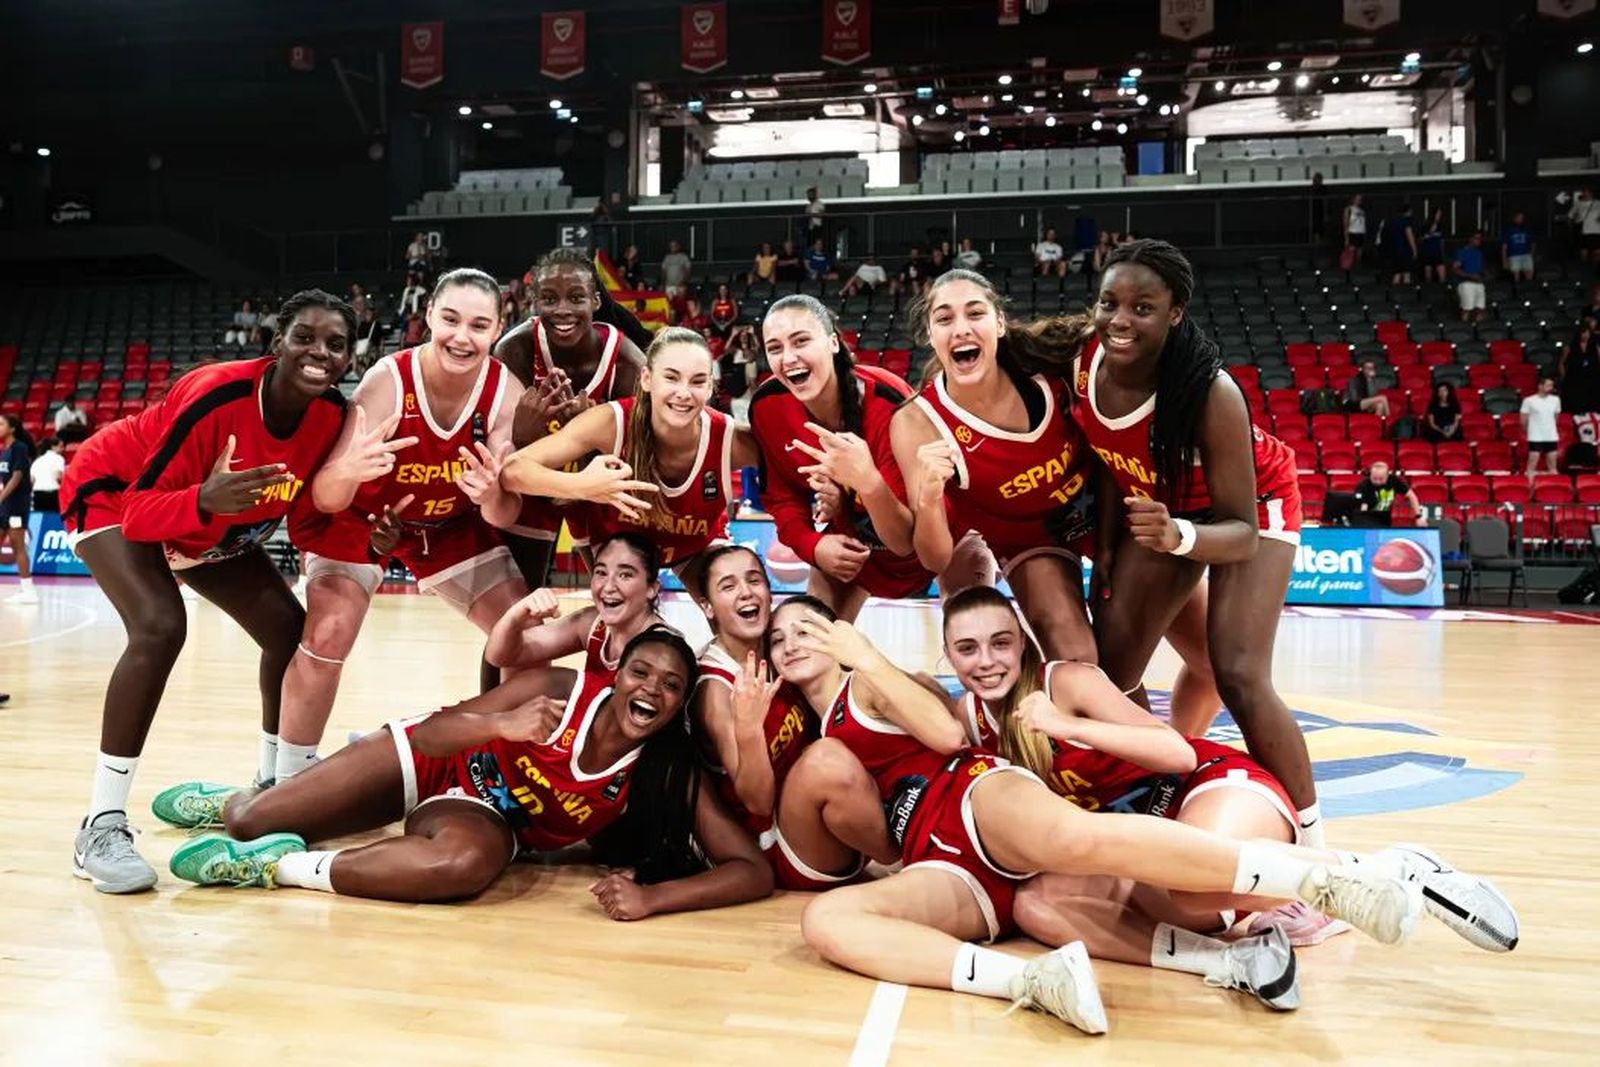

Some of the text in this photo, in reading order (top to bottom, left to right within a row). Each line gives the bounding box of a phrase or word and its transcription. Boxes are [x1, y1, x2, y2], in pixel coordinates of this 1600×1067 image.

[427, 231, 441, 250] D
[561, 227, 574, 246] E
[396, 457, 467, 485] ESPAÑ
[423, 496, 457, 516] 15
[42, 530, 72, 550] m
[1293, 545, 1362, 574] lten
[1320, 578, 1364, 595] game
[769, 705, 805, 763] ESPA
[1151, 784, 1176, 817] Bank
